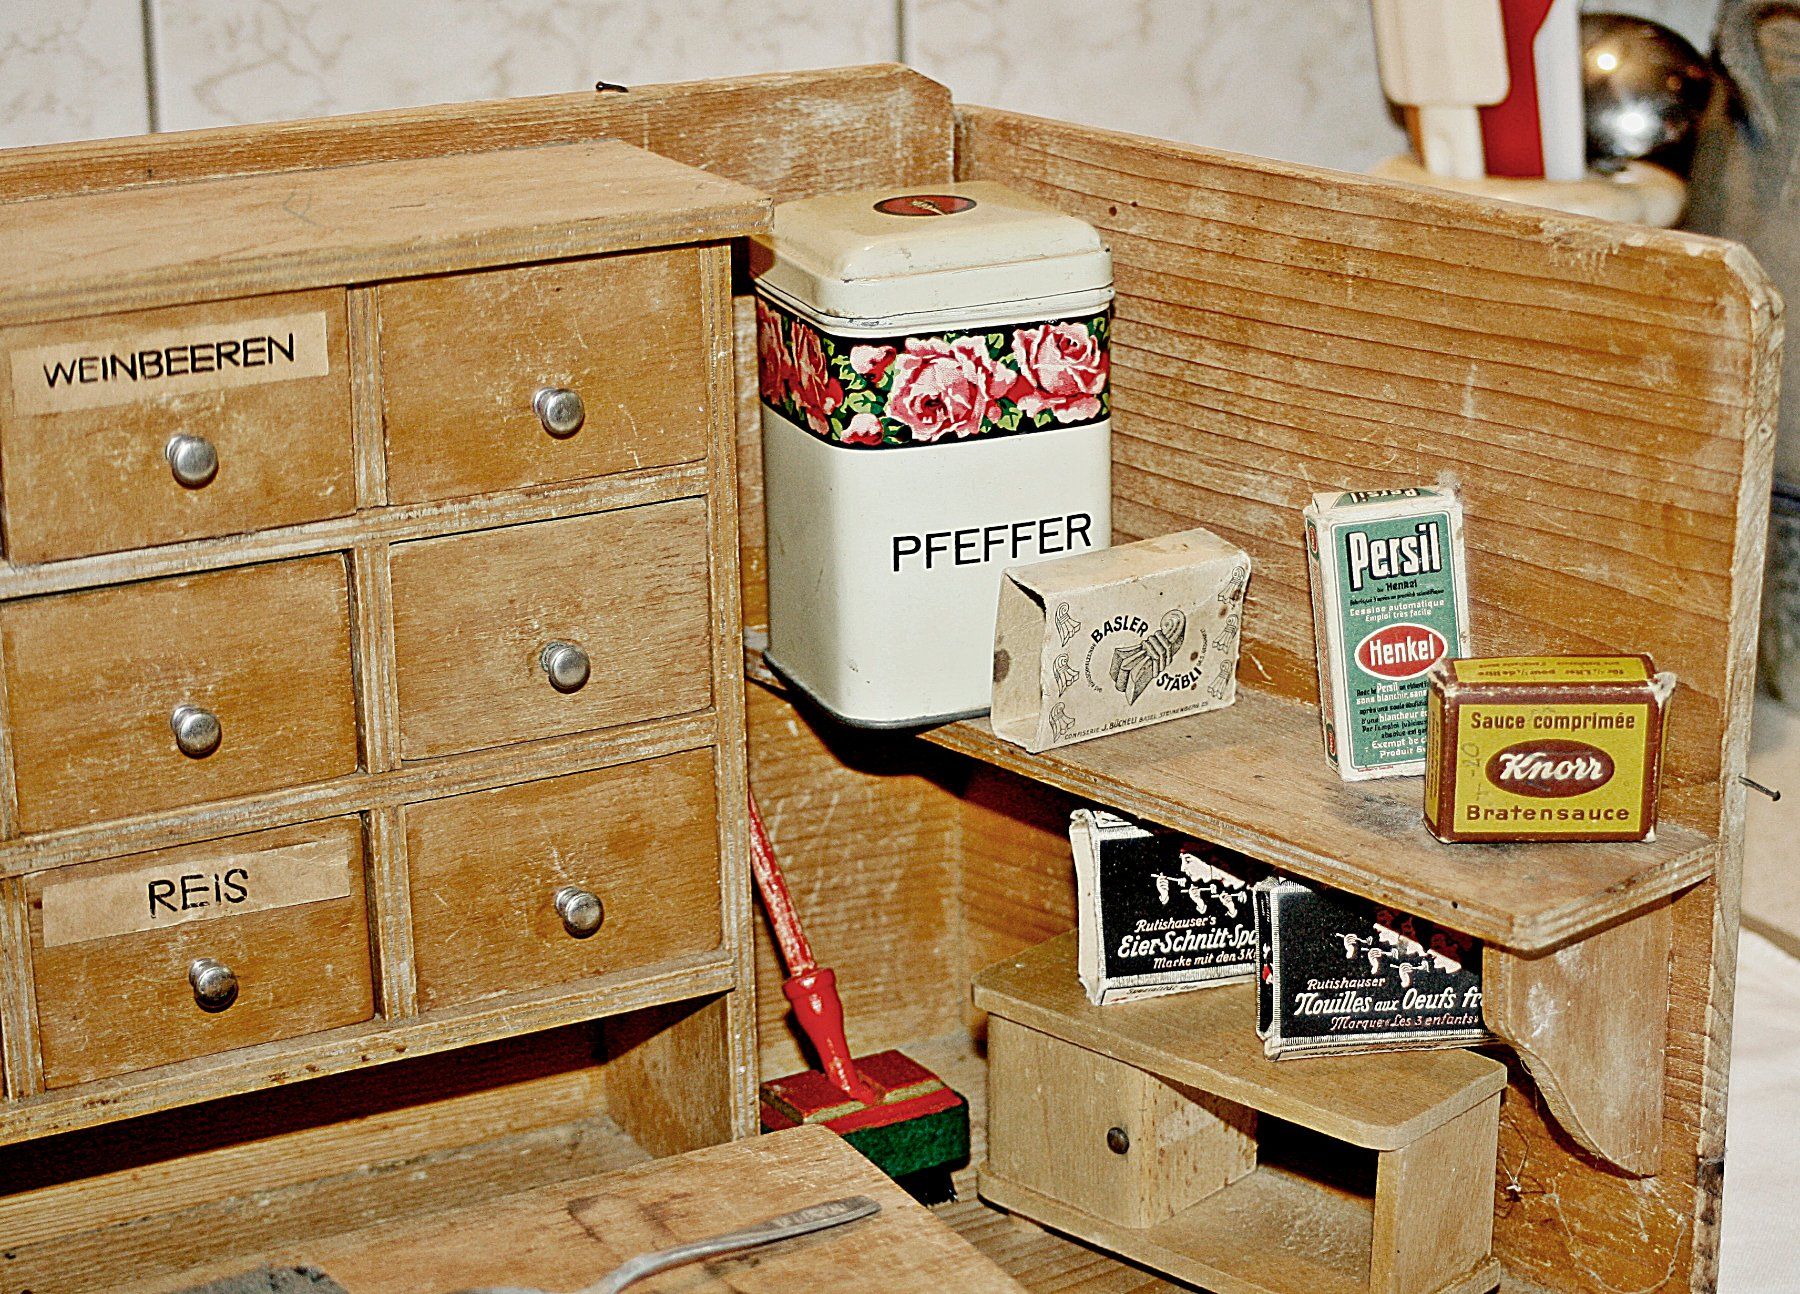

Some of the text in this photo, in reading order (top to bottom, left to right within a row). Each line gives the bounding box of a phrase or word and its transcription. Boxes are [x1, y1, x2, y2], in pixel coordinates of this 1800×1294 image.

[43, 333, 295, 388] WEINBEEREN
[892, 512, 1092, 572] PFEFFER
[1346, 521, 1442, 592] Persil
[1386, 579, 1418, 591] Henkel
[1365, 608, 1432, 622] Emploi très facile
[1389, 599, 1445, 613] automatique
[1090, 615, 1149, 644] BASLER
[1369, 633, 1435, 667] Henkel
[1156, 667, 1202, 692] STÄBLI
[1377, 682, 1398, 693] Persil
[1379, 711, 1418, 722] blancheur
[1471, 711, 1635, 732] Sauce comprimée
[1371, 738, 1405, 749] Exempt
[1379, 747, 1413, 758] Produit
[1499, 752, 1605, 781] Knorr
[1466, 804, 1630, 822] Bratensauce
[1134, 916, 1217, 933] Rutishauser's
[1153, 955, 1192, 970] Marke
[1194, 952, 1214, 965] mit
[1216, 950, 1236, 964] den
[1307, 977, 1387, 990] Rutishauser
[1293, 986, 1483, 1016] Nouilles aux Oeufs fr
[1330, 1017, 1383, 1031] Marque
[1415, 1015, 1423, 1026] 3
